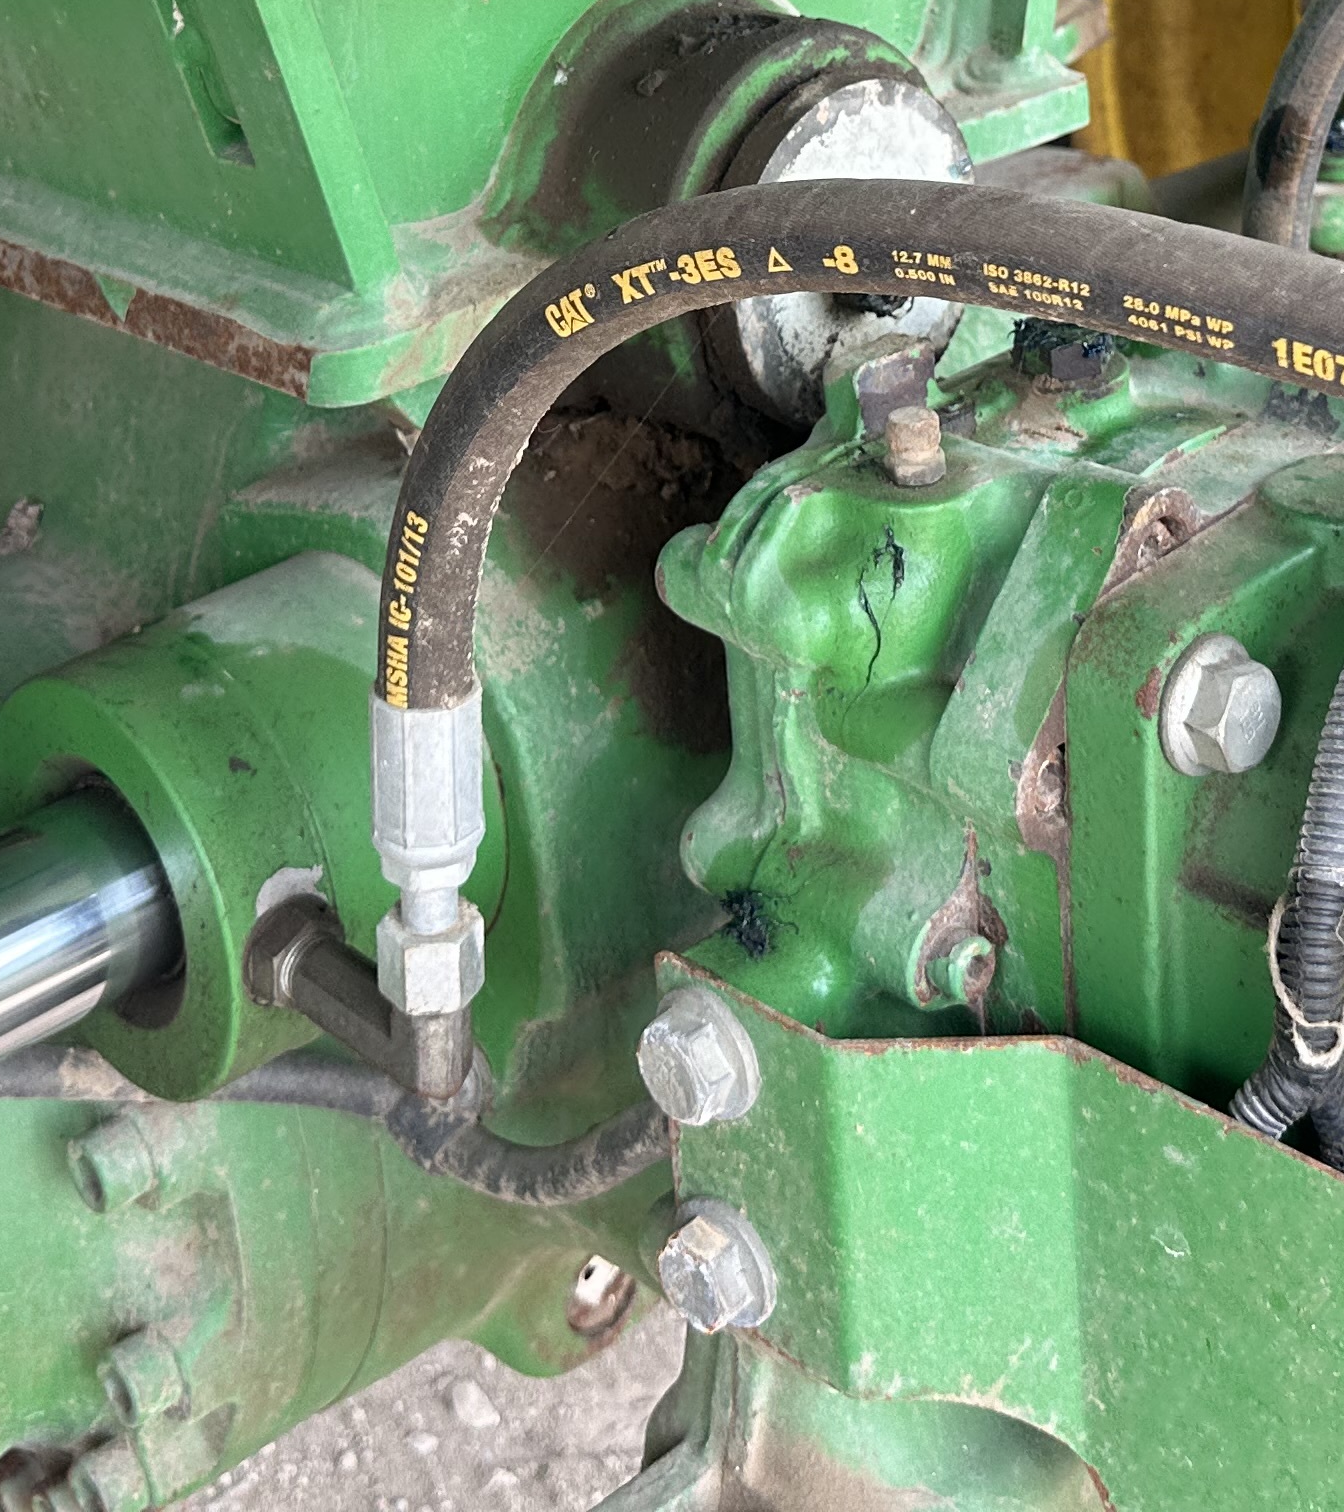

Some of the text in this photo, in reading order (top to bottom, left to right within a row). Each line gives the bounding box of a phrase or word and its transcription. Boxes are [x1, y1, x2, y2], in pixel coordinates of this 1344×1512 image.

[822, 244, 859, 275] -8
[891, 250, 952, 269] 12.7 MM
[894, 267, 956, 286] 0.500 IN
[982, 262, 1091, 297] ISO 3862-R12
[987, 281, 1084, 311] SAE 100R12
[1122, 295, 1235, 335] 28.0 MPa WP
[1173, 324, 1203, 344] PSI
[1206, 334, 1235, 351] WP
[385, 510, 429, 709] MSHA IC-101/13
